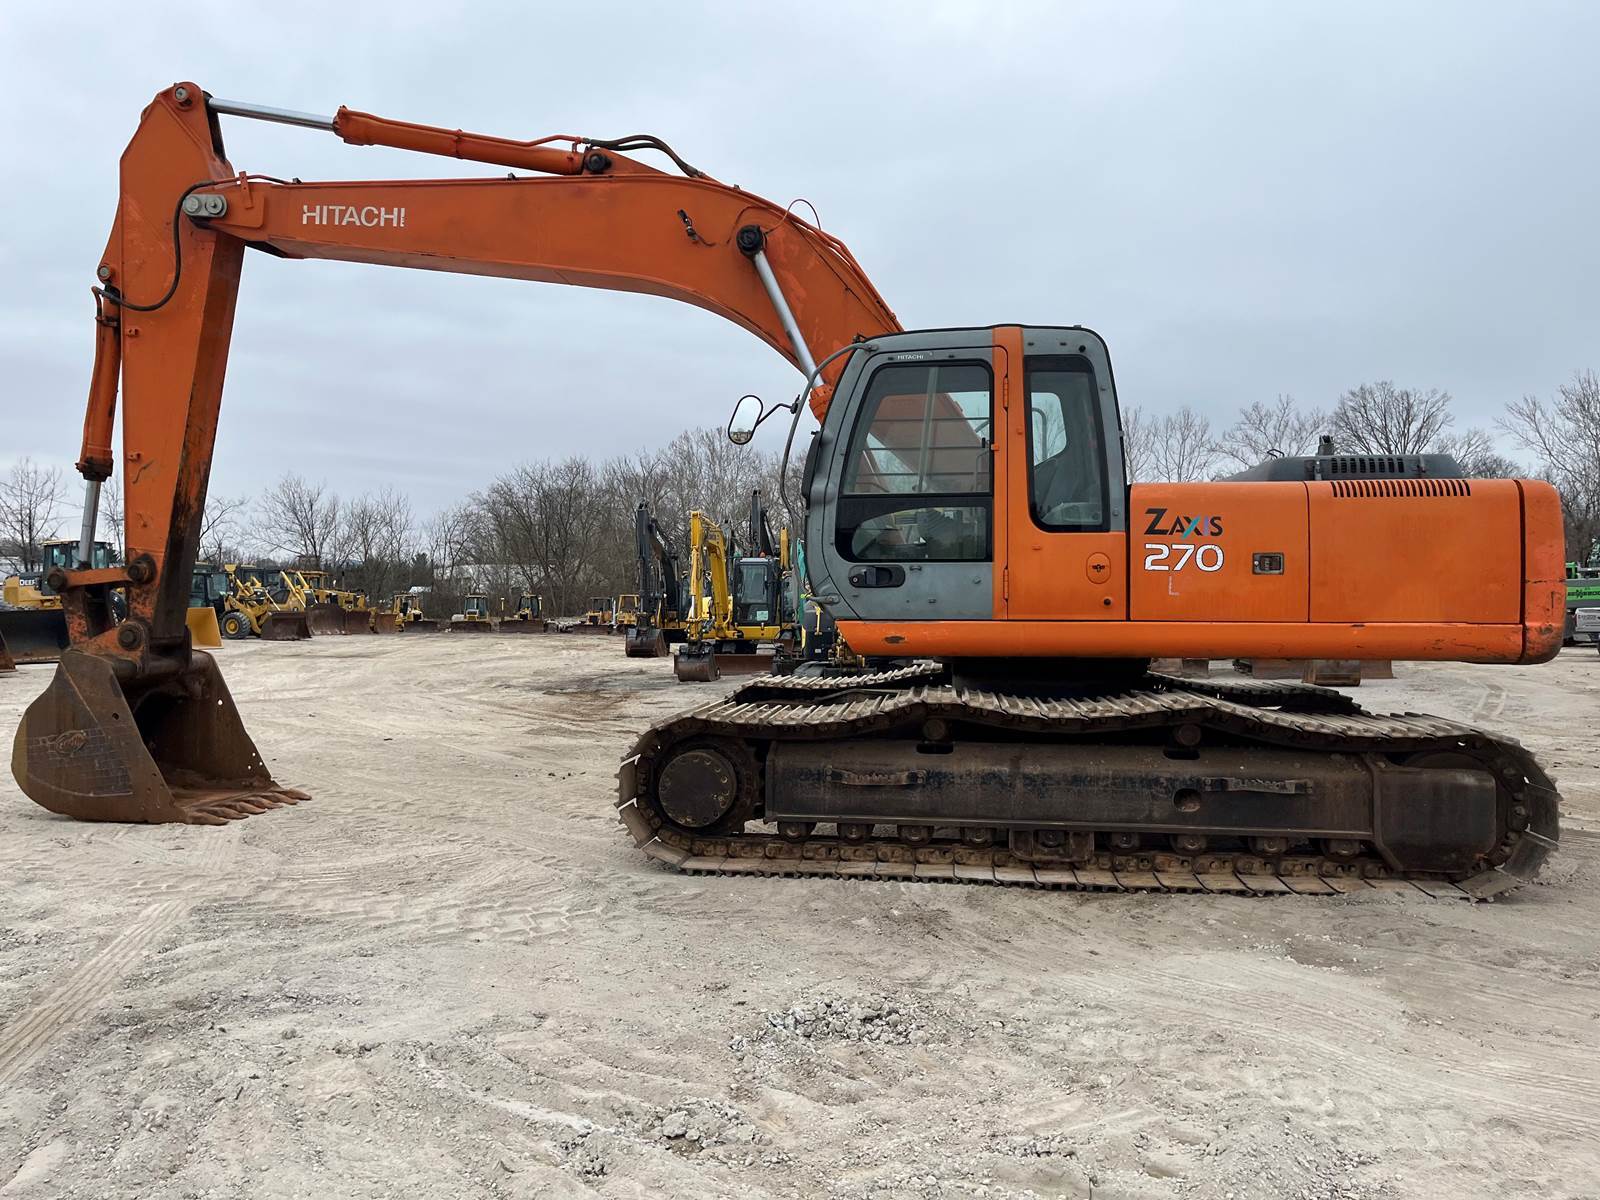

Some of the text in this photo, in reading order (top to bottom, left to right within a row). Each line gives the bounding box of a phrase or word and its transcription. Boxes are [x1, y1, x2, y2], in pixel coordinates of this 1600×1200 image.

[302, 204, 406, 227] HITACHI
[1144, 508, 1224, 540] ZAXIS
[1144, 543, 1225, 572] 270
